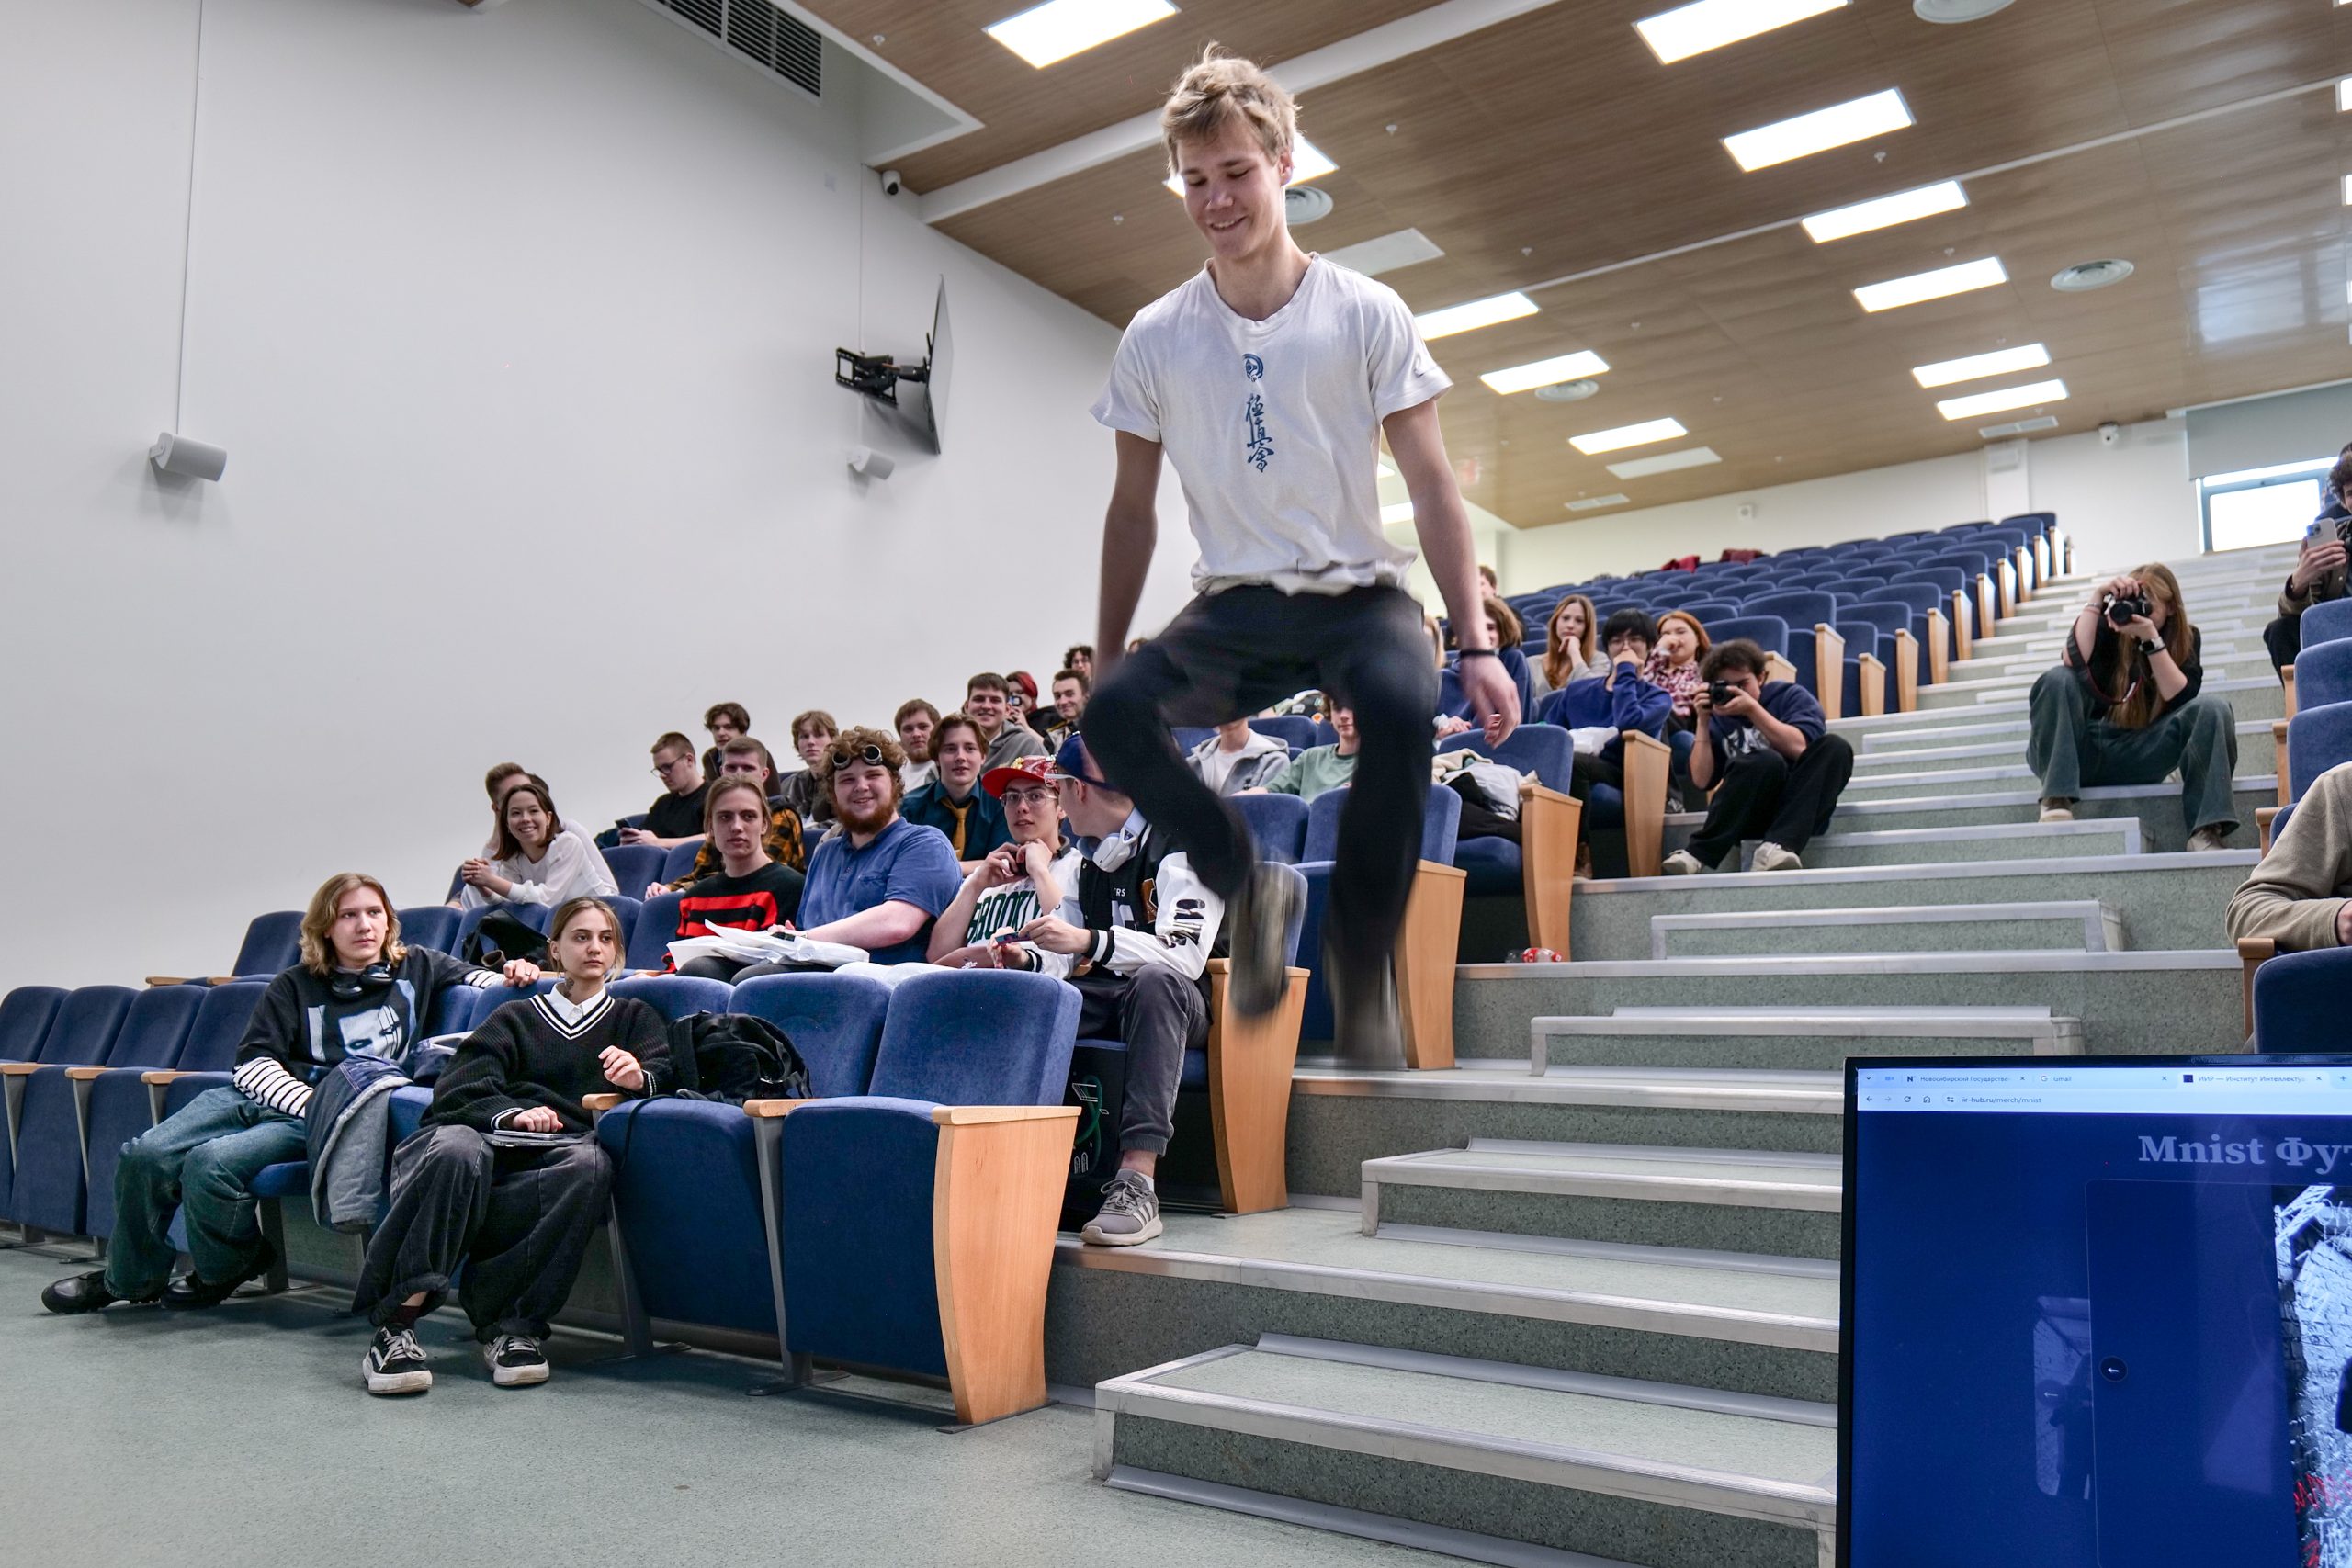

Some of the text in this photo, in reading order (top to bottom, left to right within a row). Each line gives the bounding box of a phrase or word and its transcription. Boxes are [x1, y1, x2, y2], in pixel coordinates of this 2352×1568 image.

[1114, 887, 1126, 897] RS
[1920, 1076, 1969, 1084] Новосибирский
[2226, 1076, 2257, 1084] Институт
[1961, 1096, 2041, 1104] iir-hub.ru/merch/mnist
[2138, 1134, 2266, 1165] Mnist
